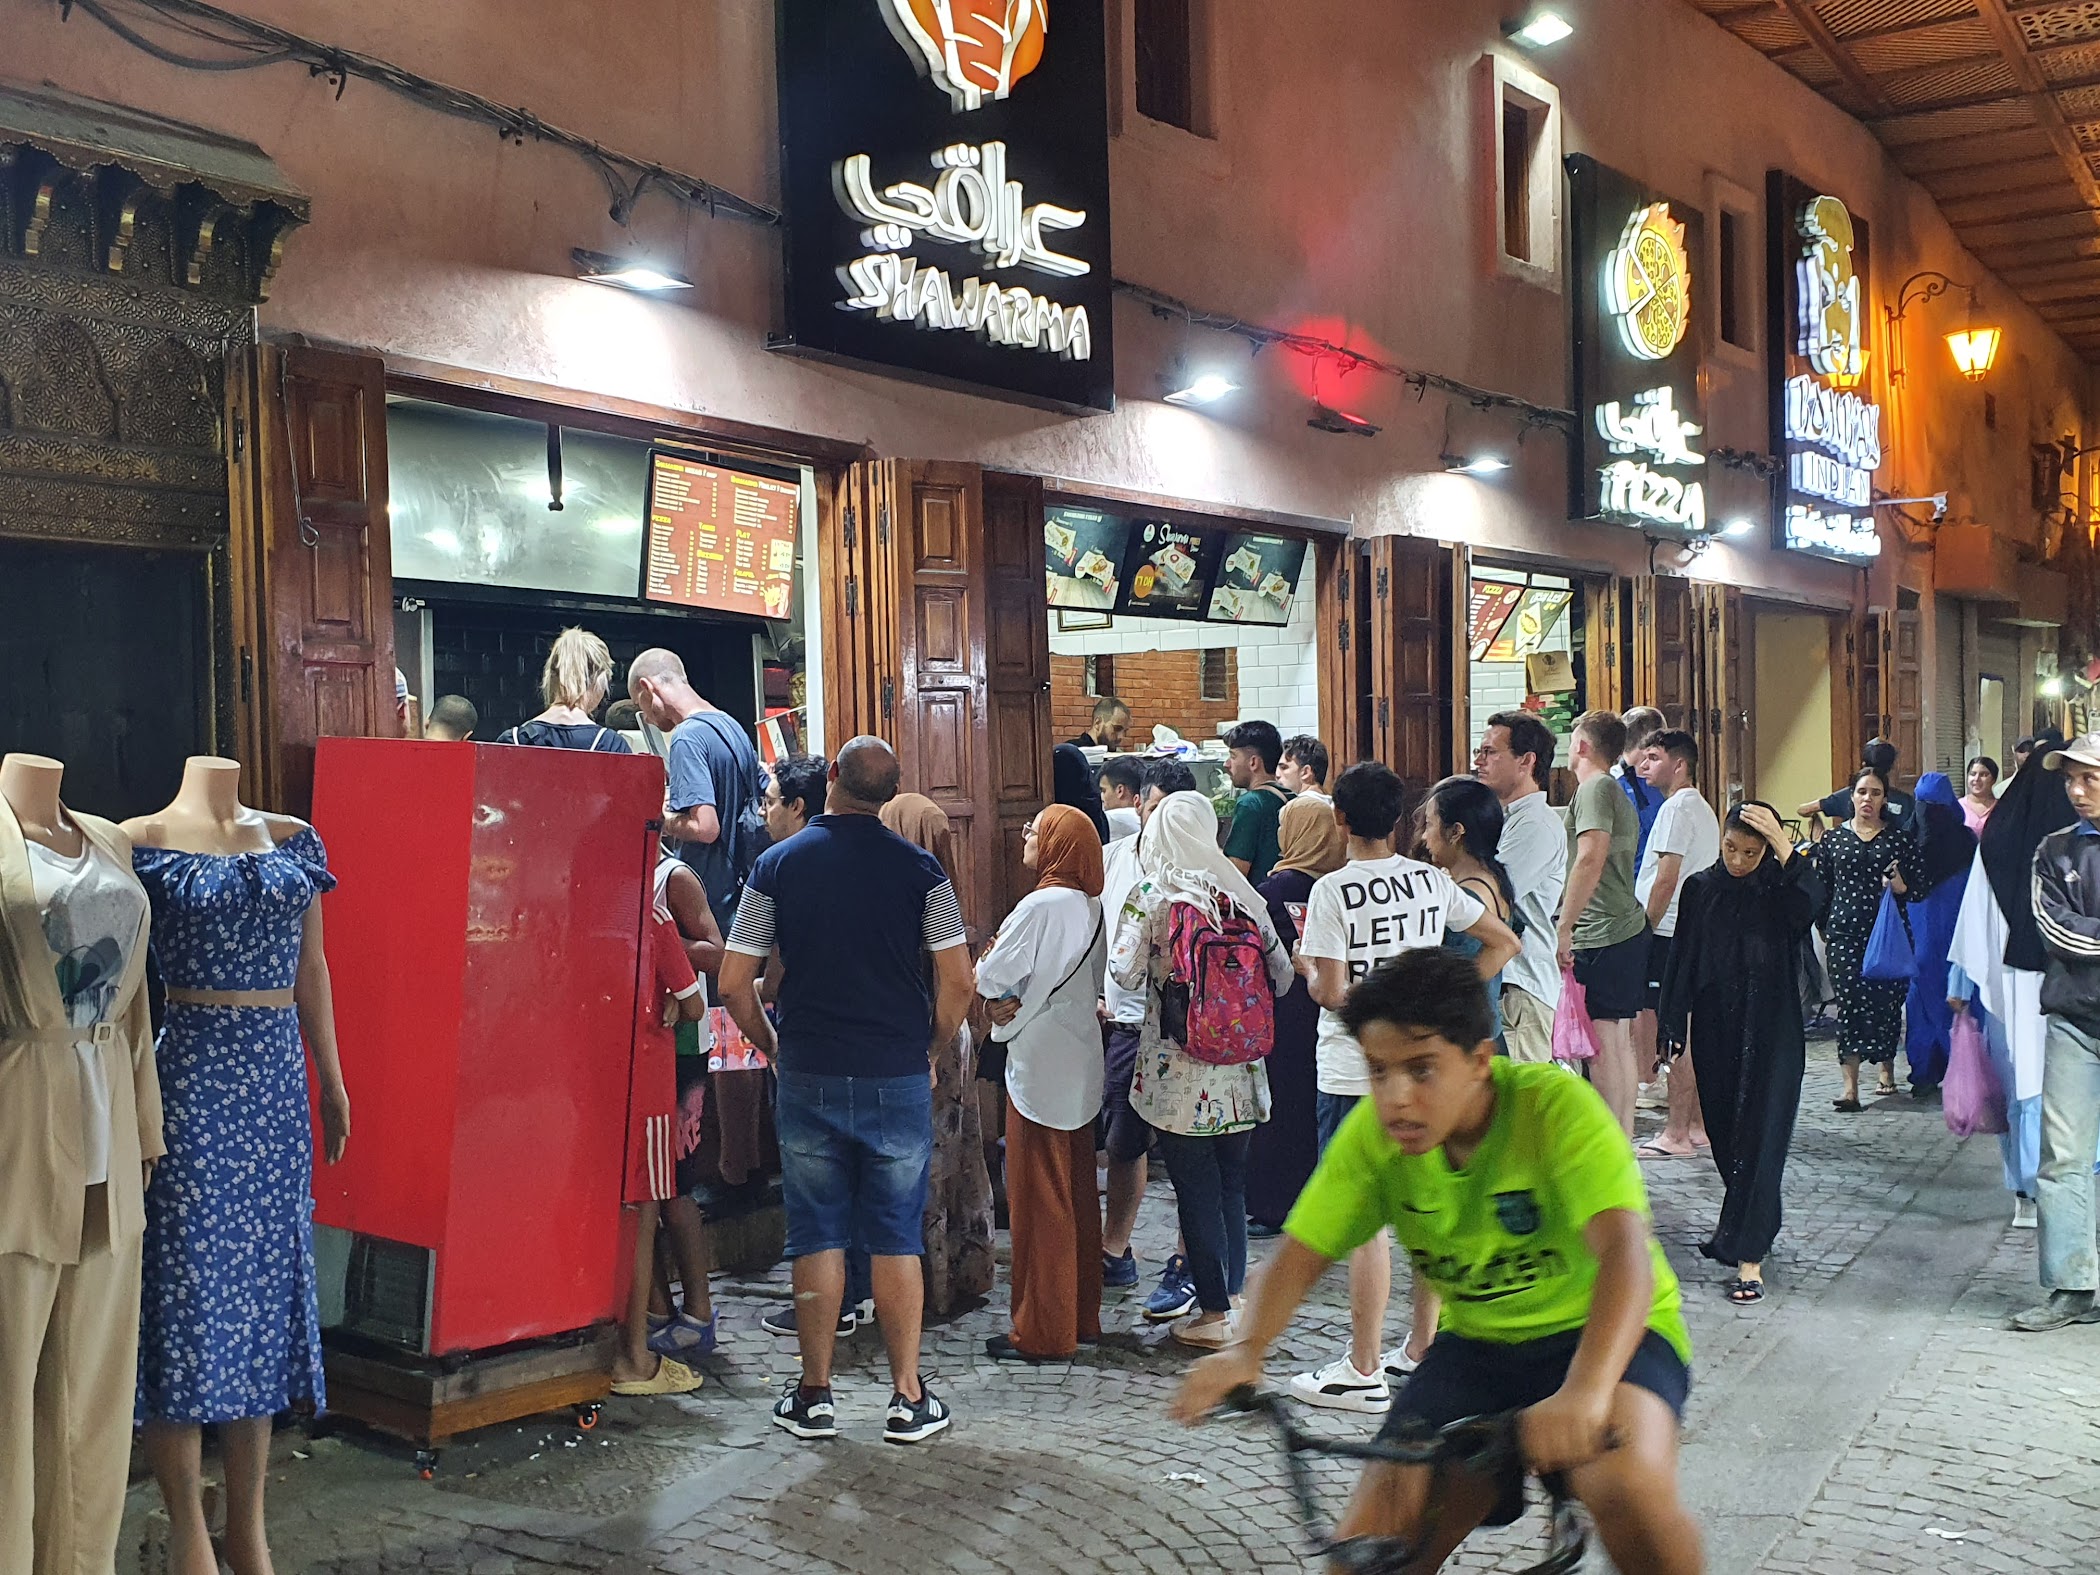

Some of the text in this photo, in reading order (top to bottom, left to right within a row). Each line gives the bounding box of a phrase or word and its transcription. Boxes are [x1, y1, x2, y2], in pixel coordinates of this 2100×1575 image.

[845, 253, 1091, 361] SHAWARMA
[1788, 375, 1880, 470] BOMBAY
[1794, 452, 1871, 507] INDIAN
[1340, 870, 1432, 910] DON'T
[1349, 906, 1440, 949] LET IT
